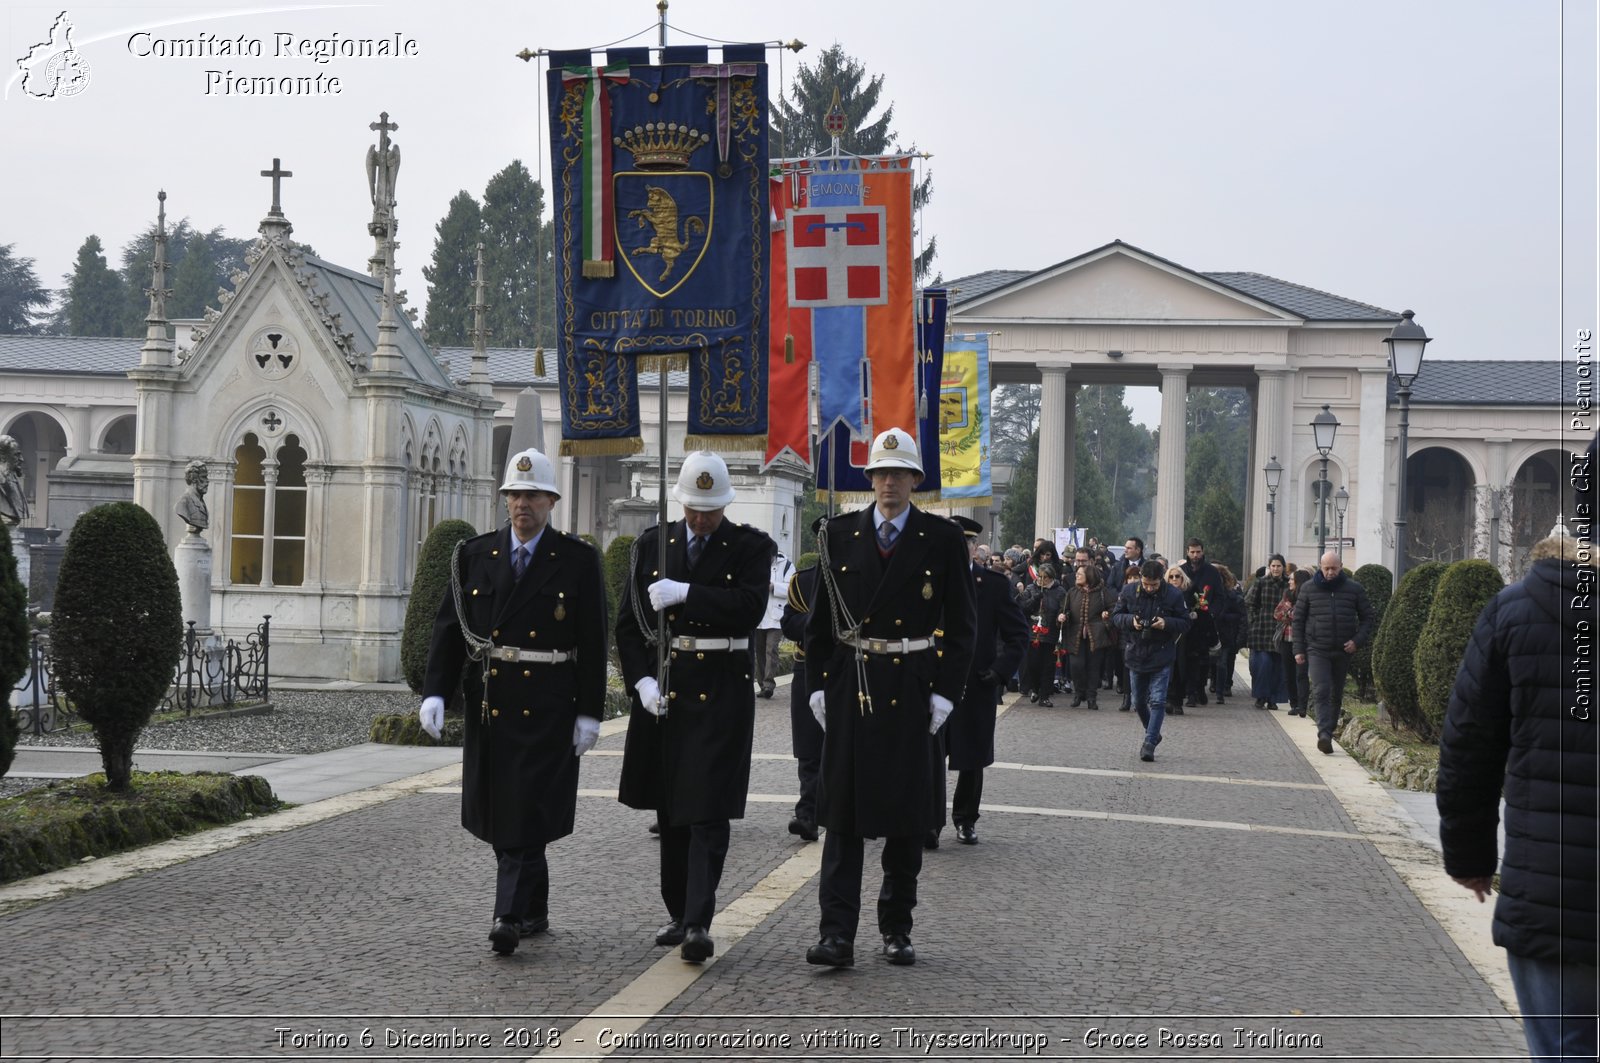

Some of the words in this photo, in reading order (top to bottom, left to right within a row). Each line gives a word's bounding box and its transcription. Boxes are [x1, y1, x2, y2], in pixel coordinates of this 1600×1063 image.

[800, 182, 872, 200] PIEMONTE
[650, 308, 664, 328] DI
[671, 308, 737, 329] TORINO
